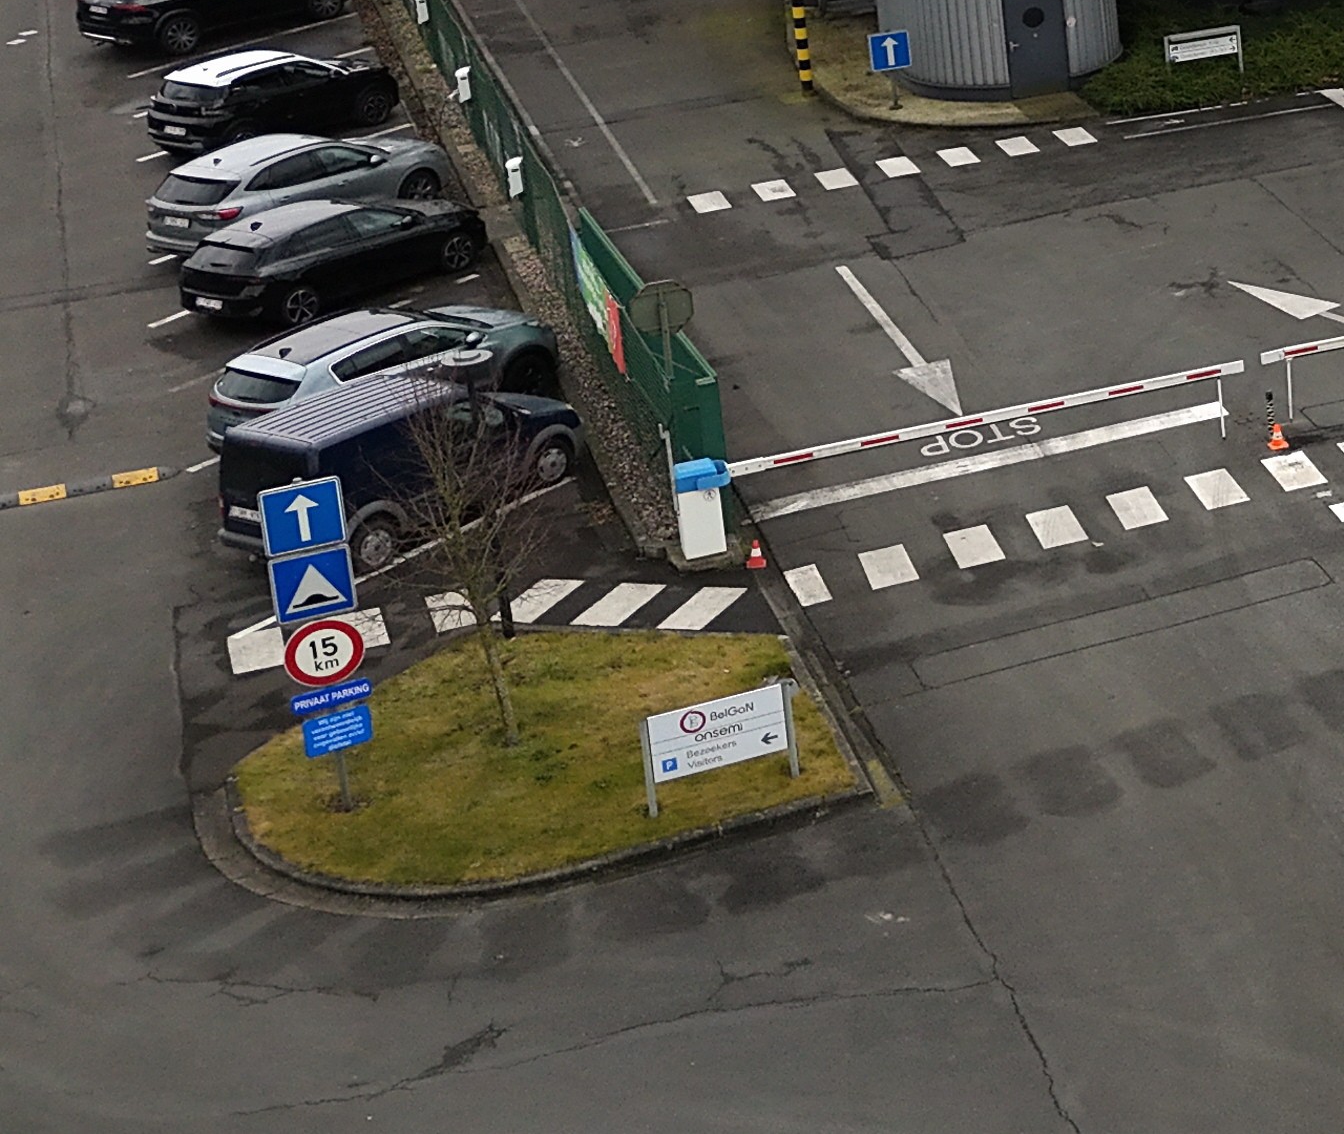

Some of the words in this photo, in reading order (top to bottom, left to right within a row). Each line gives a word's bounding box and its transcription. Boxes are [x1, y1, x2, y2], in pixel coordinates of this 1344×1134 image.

[920, 416, 1041, 456] STOP
[309, 636, 338, 659] 15
[314, 657, 340, 672] km
[293, 694, 330, 711] PRIVAAT
[331, 683, 370, 700] PARKING
[710, 702, 754, 721] BelGaN
[695, 723, 743, 742] onsemi
[686, 740, 737, 759] Bezoekers
[688, 754, 723, 769] Visitors
